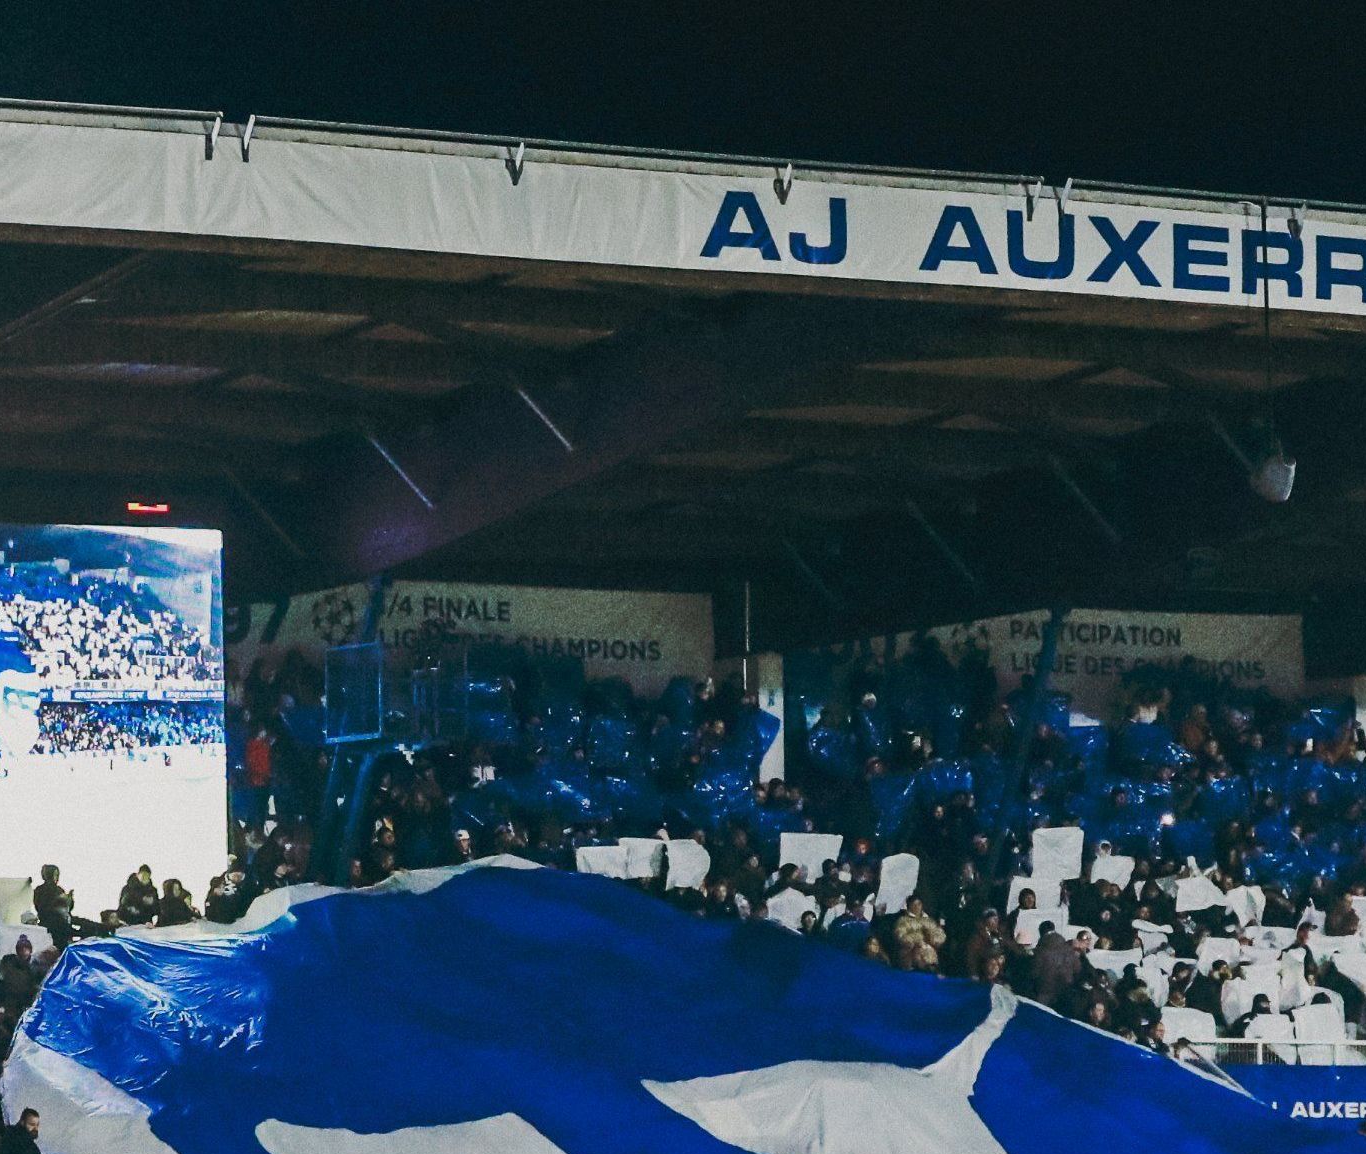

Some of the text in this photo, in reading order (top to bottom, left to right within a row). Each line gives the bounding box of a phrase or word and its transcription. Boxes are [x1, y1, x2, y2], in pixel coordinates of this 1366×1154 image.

[699, 190, 848, 266] AJ
[422, 596, 512, 623] FINALE
[1009, 619, 1182, 647] PATICIPATION
[1010, 653, 1079, 675] LIUE
